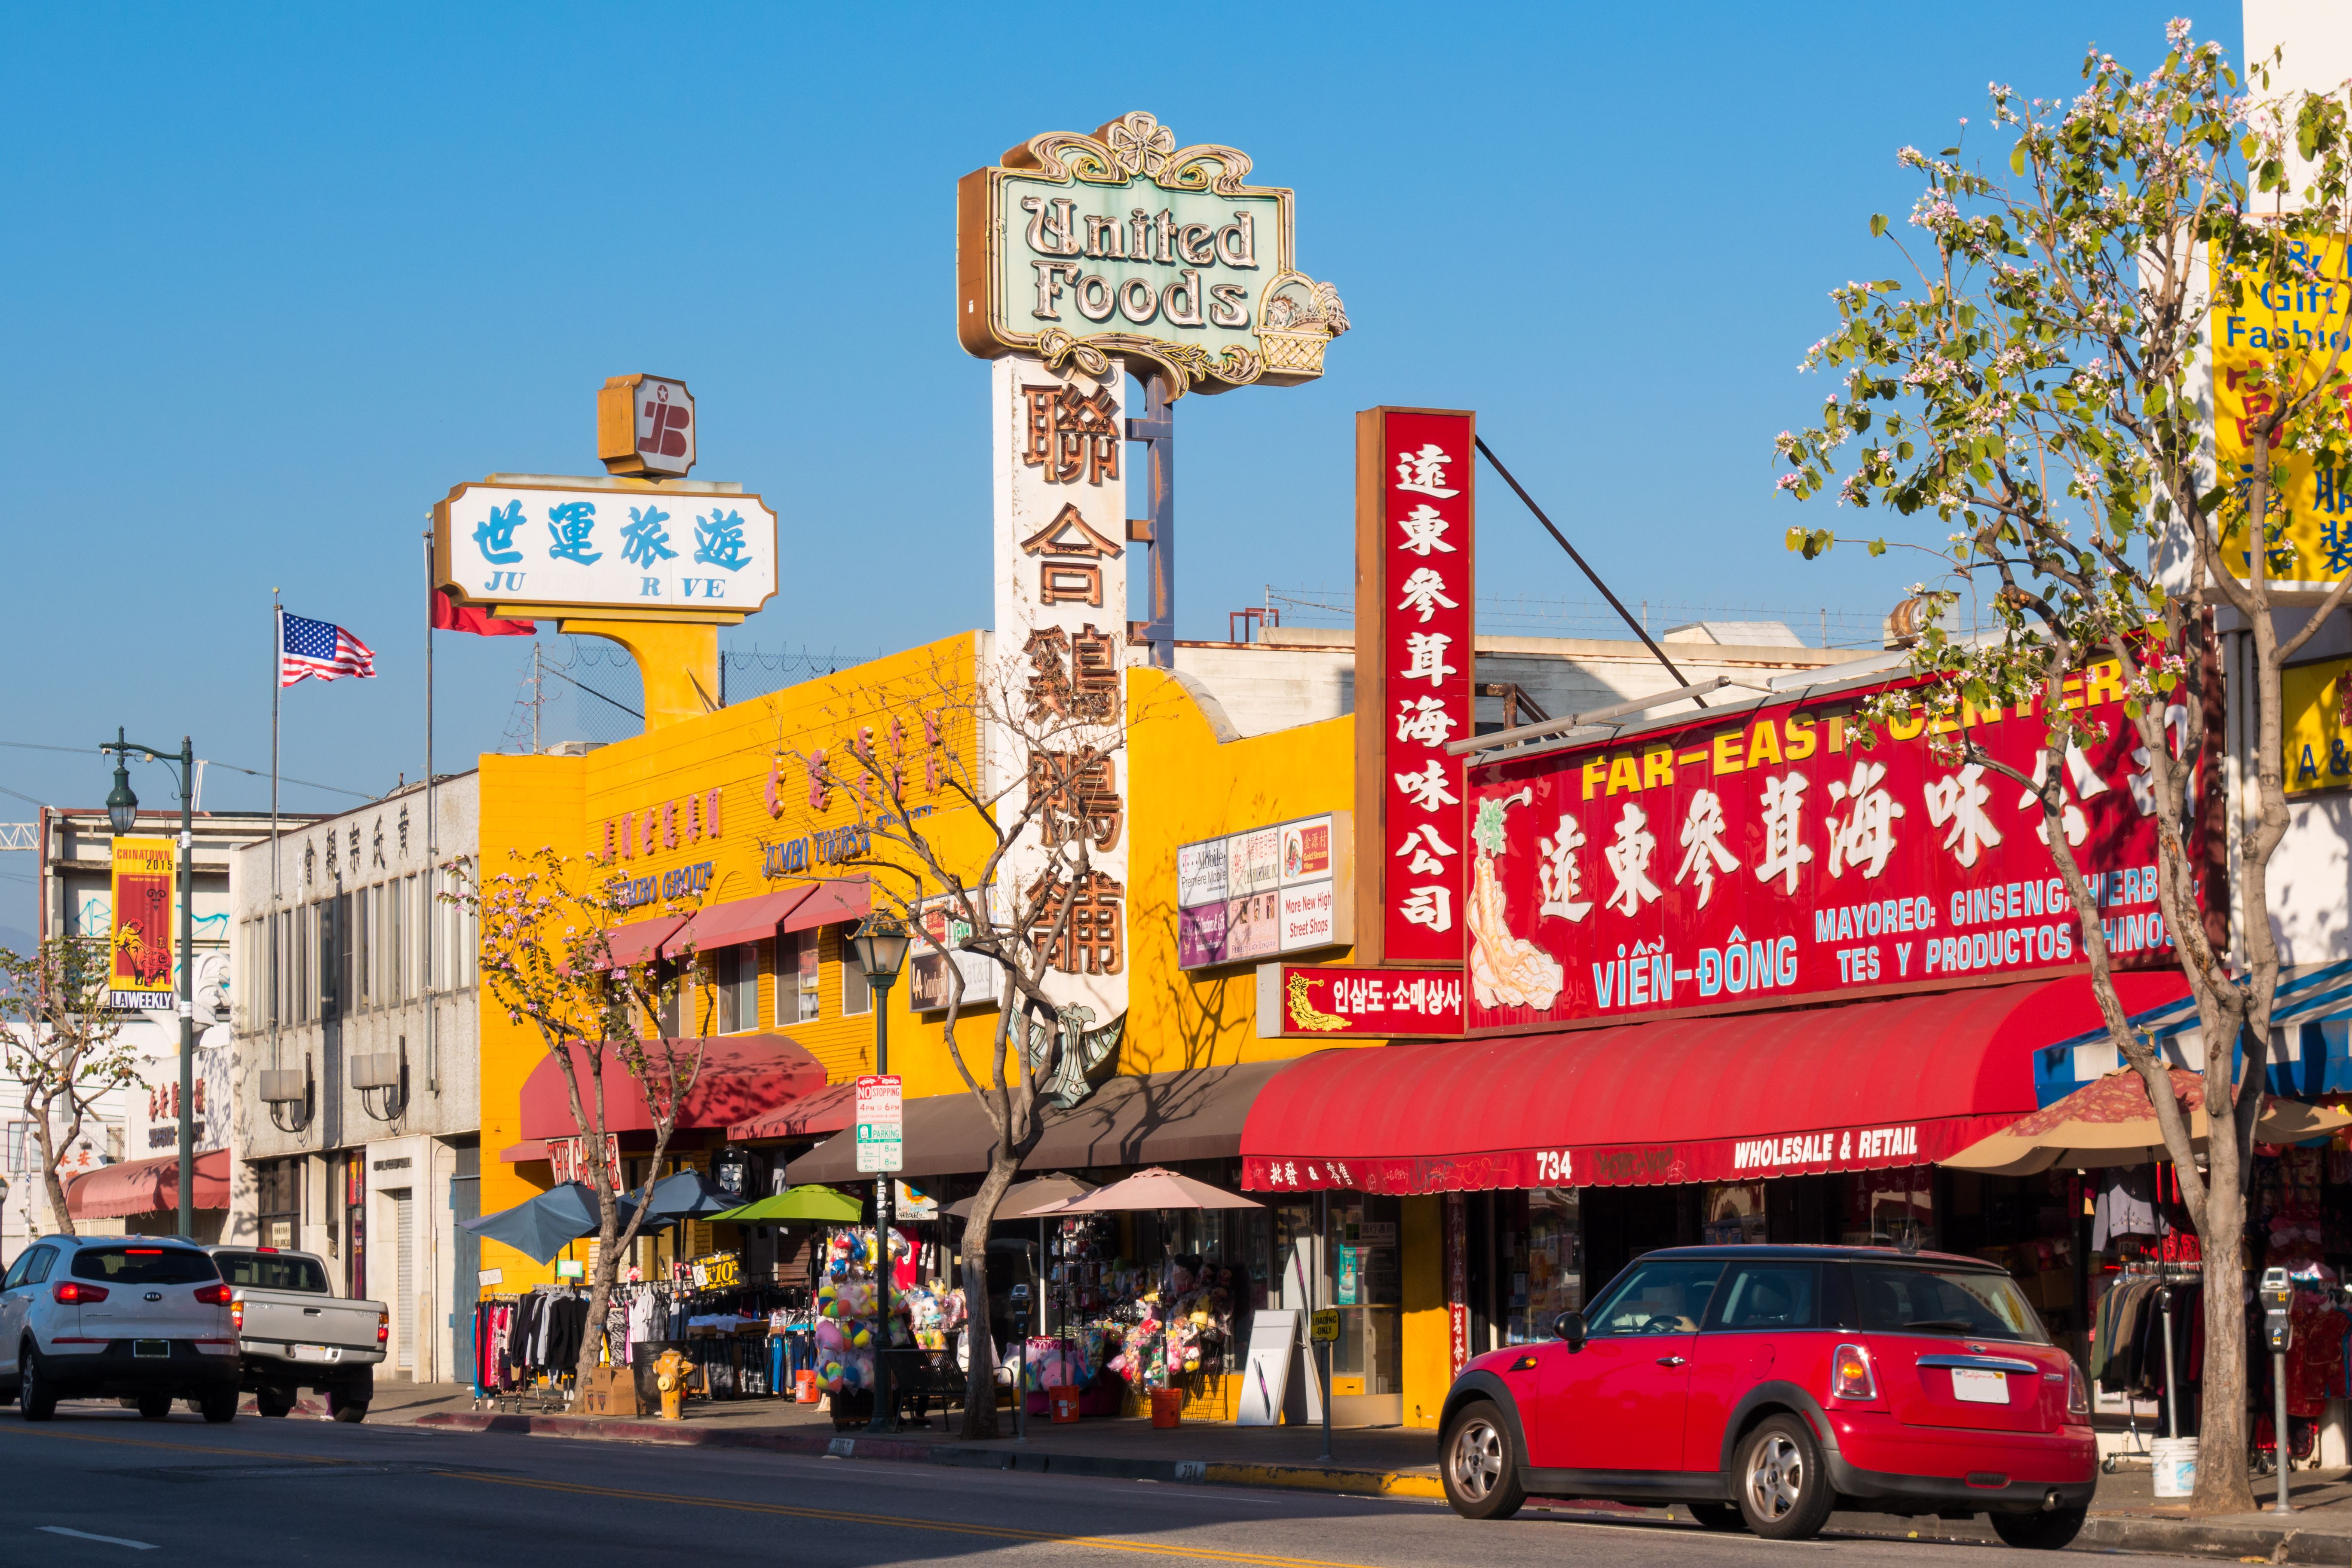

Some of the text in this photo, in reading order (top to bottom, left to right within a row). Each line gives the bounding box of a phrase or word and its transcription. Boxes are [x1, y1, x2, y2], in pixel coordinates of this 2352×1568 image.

[1021, 195, 1257, 267] United
[1032, 260, 1249, 328] Foods
[2260, 280, 2338, 314] Gift
[472, 499, 753, 573] 世運旅遊
[1582, 704, 1853, 801] FAR-EAST
[2298, 744, 2318, 781] A
[116, 848, 170, 861] CHINATOWN
[146, 859, 173, 871] 2015
[761, 836, 811, 878] JUMBO
[1313, 851, 1327, 860] Stream
[662, 861, 714, 899] GROUP
[1182, 869, 1226, 889] Premiere Mobile
[1286, 890, 1331, 914] More New High
[1815, 895, 1936, 943] MAYOREO:
[1951, 876, 2071, 927] GINSENG,
[1290, 922, 1309, 938] Street
[1310, 919, 1328, 937] Shops
[1837, 947, 1880, 983] TES
[1896, 943, 1912, 977] Y
[1925, 923, 2071, 974] PRODUCTOS
[924, 970, 948, 999] Sandwich
[128, 992, 172, 1009] WEEKLY
[858, 1087, 900, 1099] NO STOPPING
[873, 1130, 900, 1138] PARKING
[1734, 1126, 1917, 1169] WHOLESALE & RETAIL
[547, 1139, 570, 1185] THE
[1270, 1161, 1298, 1186] 批發
[1308, 1166, 1319, 1181] &
[1536, 1151, 1572, 1180] 734
[1312, 1315, 1337, 1326] LOADING
[1317, 1325, 1332, 1335] ONLY
